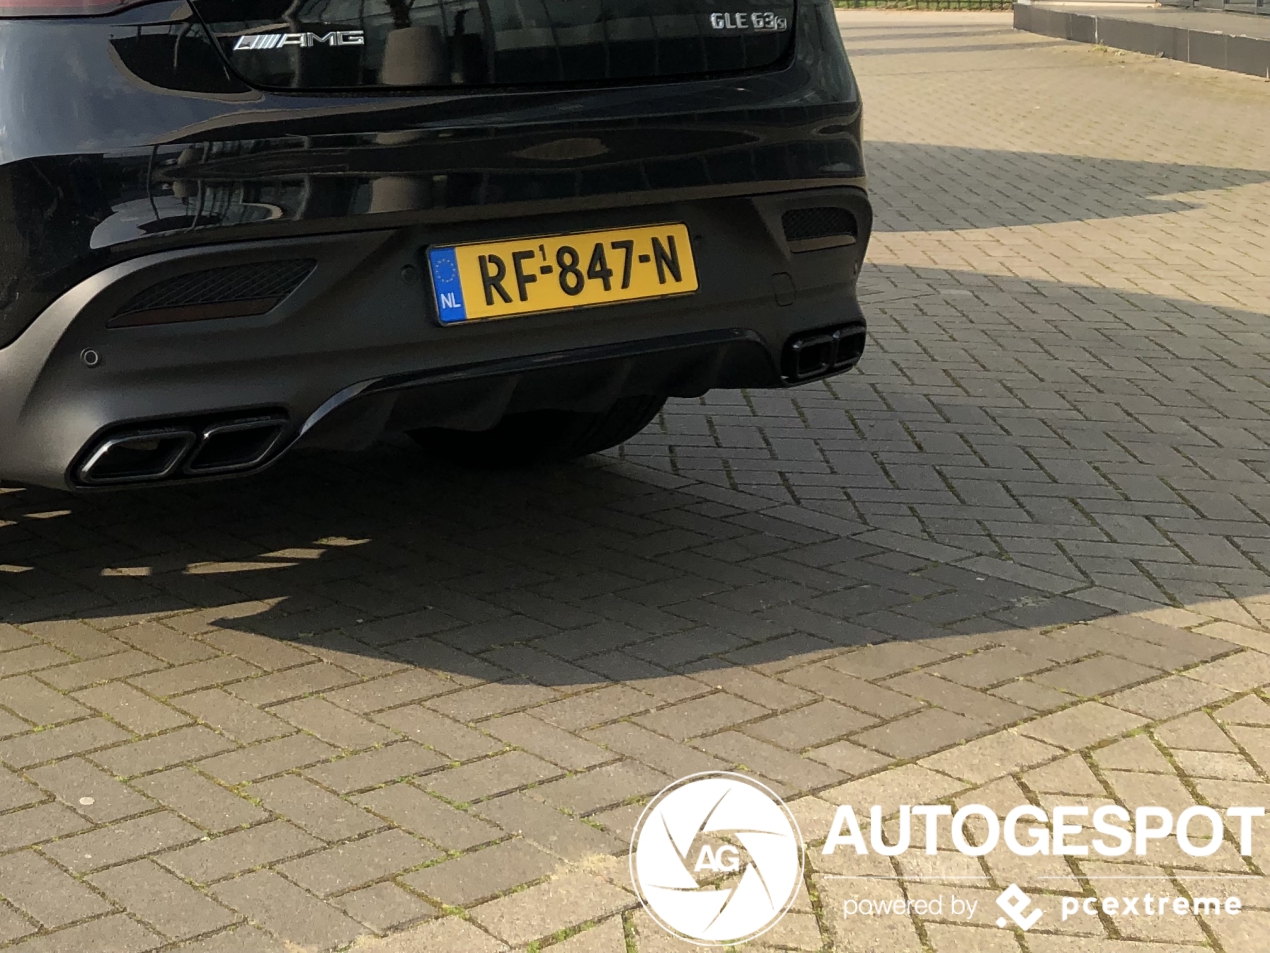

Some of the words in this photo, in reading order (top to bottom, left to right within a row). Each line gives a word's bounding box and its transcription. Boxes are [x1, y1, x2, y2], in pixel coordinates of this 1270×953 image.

[710, 12, 749, 29] GLE
[276, 30, 365, 49] AMG
[478, 235, 683, 306] RF-847-N
[440, 293, 461, 310] NL
